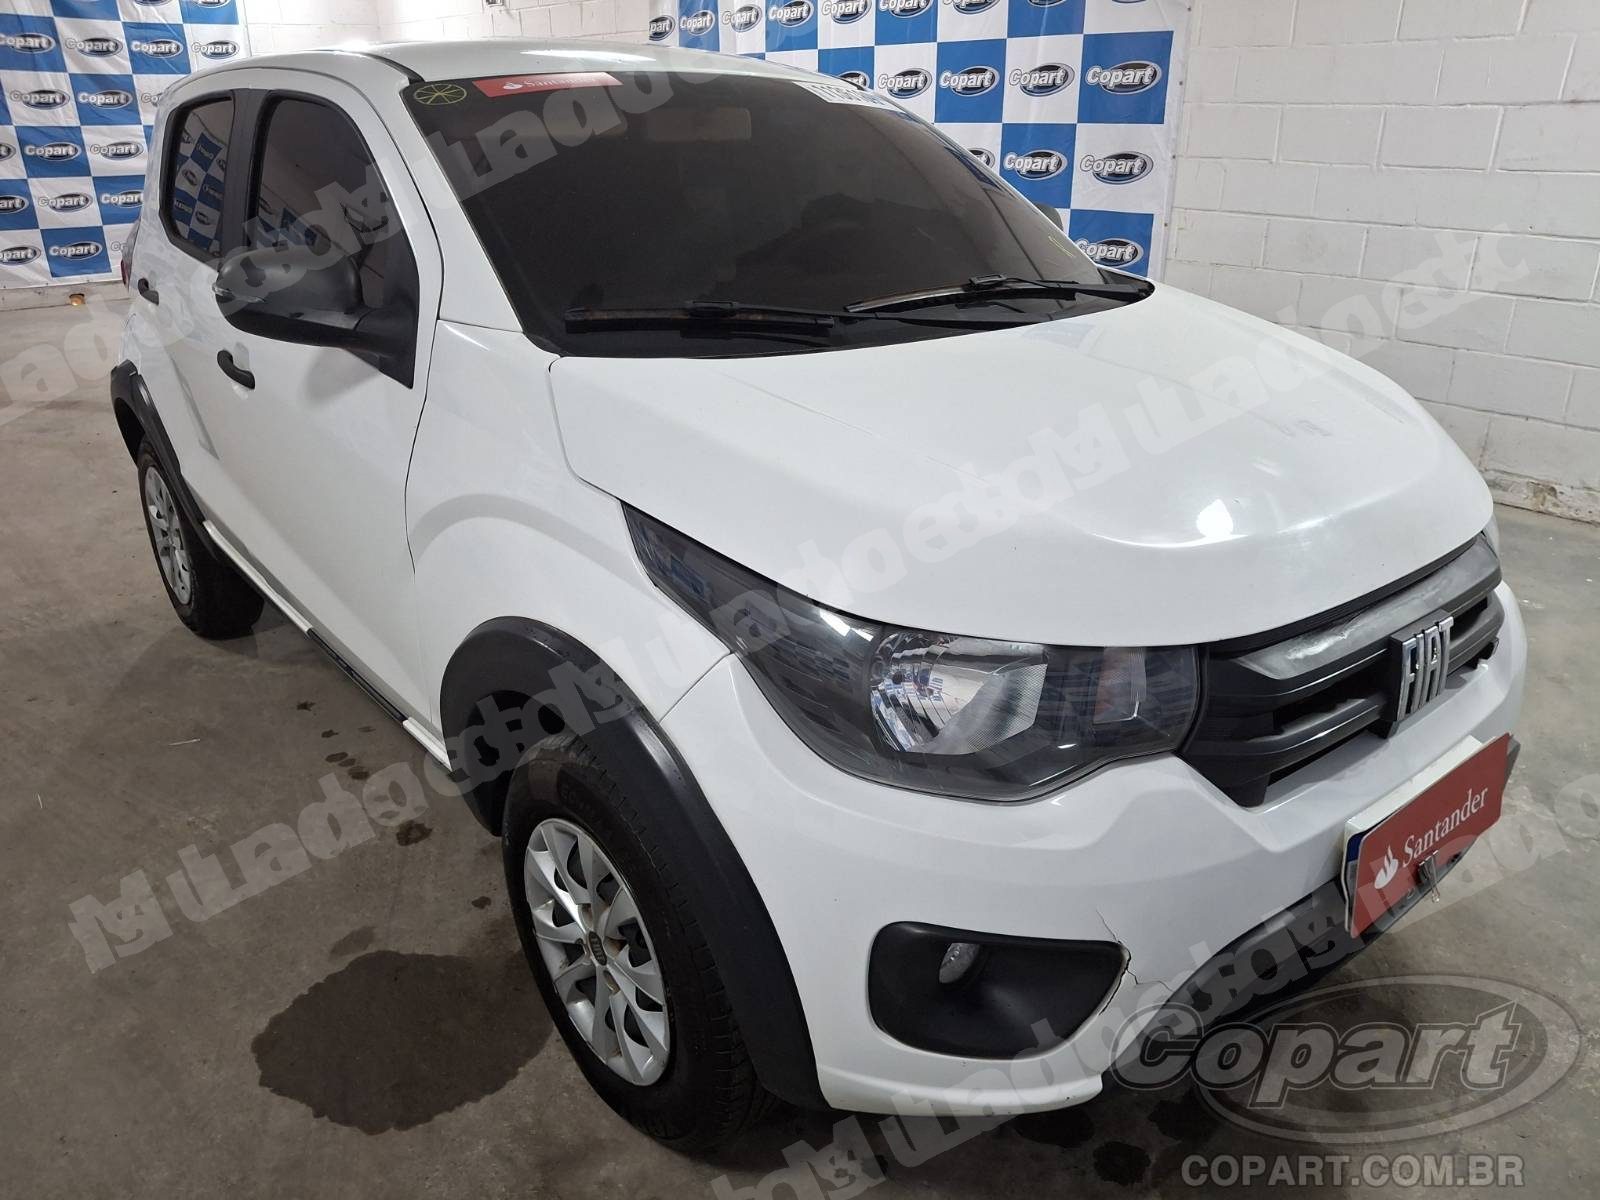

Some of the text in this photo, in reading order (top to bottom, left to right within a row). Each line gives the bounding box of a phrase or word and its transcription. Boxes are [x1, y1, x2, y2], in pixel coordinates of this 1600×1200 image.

[721, 8, 757, 26] Copart
[768, 4, 809, 23] Copart
[822, 0, 865, 18] Copart
[649, 20, 670, 35] part
[680, 14, 711, 32] Copart
[65, 38, 116, 52] Copart
[131, 40, 178, 55] Copart
[192, 42, 235, 55] Copart
[879, 72, 926, 92] Copart
[940, 69, 994, 91] Copart
[1009, 67, 1066, 89] Copart
[1086, 64, 1154, 89] Copart
[9, 90, 63, 105] Copart
[78, 91, 127, 106] Copart
[25, 144, 75, 157] Copart
[90, 144, 138, 156] Copart
[1003, 152, 1059, 174] Copart
[1080, 154, 1144, 176] Copart
[0, 197, 21, 208] art
[38, 196, 87, 208] Copart
[0, 248, 34, 262] opart
[49, 245, 97, 258] Copart
[1396, 616, 1454, 720] FIAT
[1402, 787, 1488, 868] Santander
